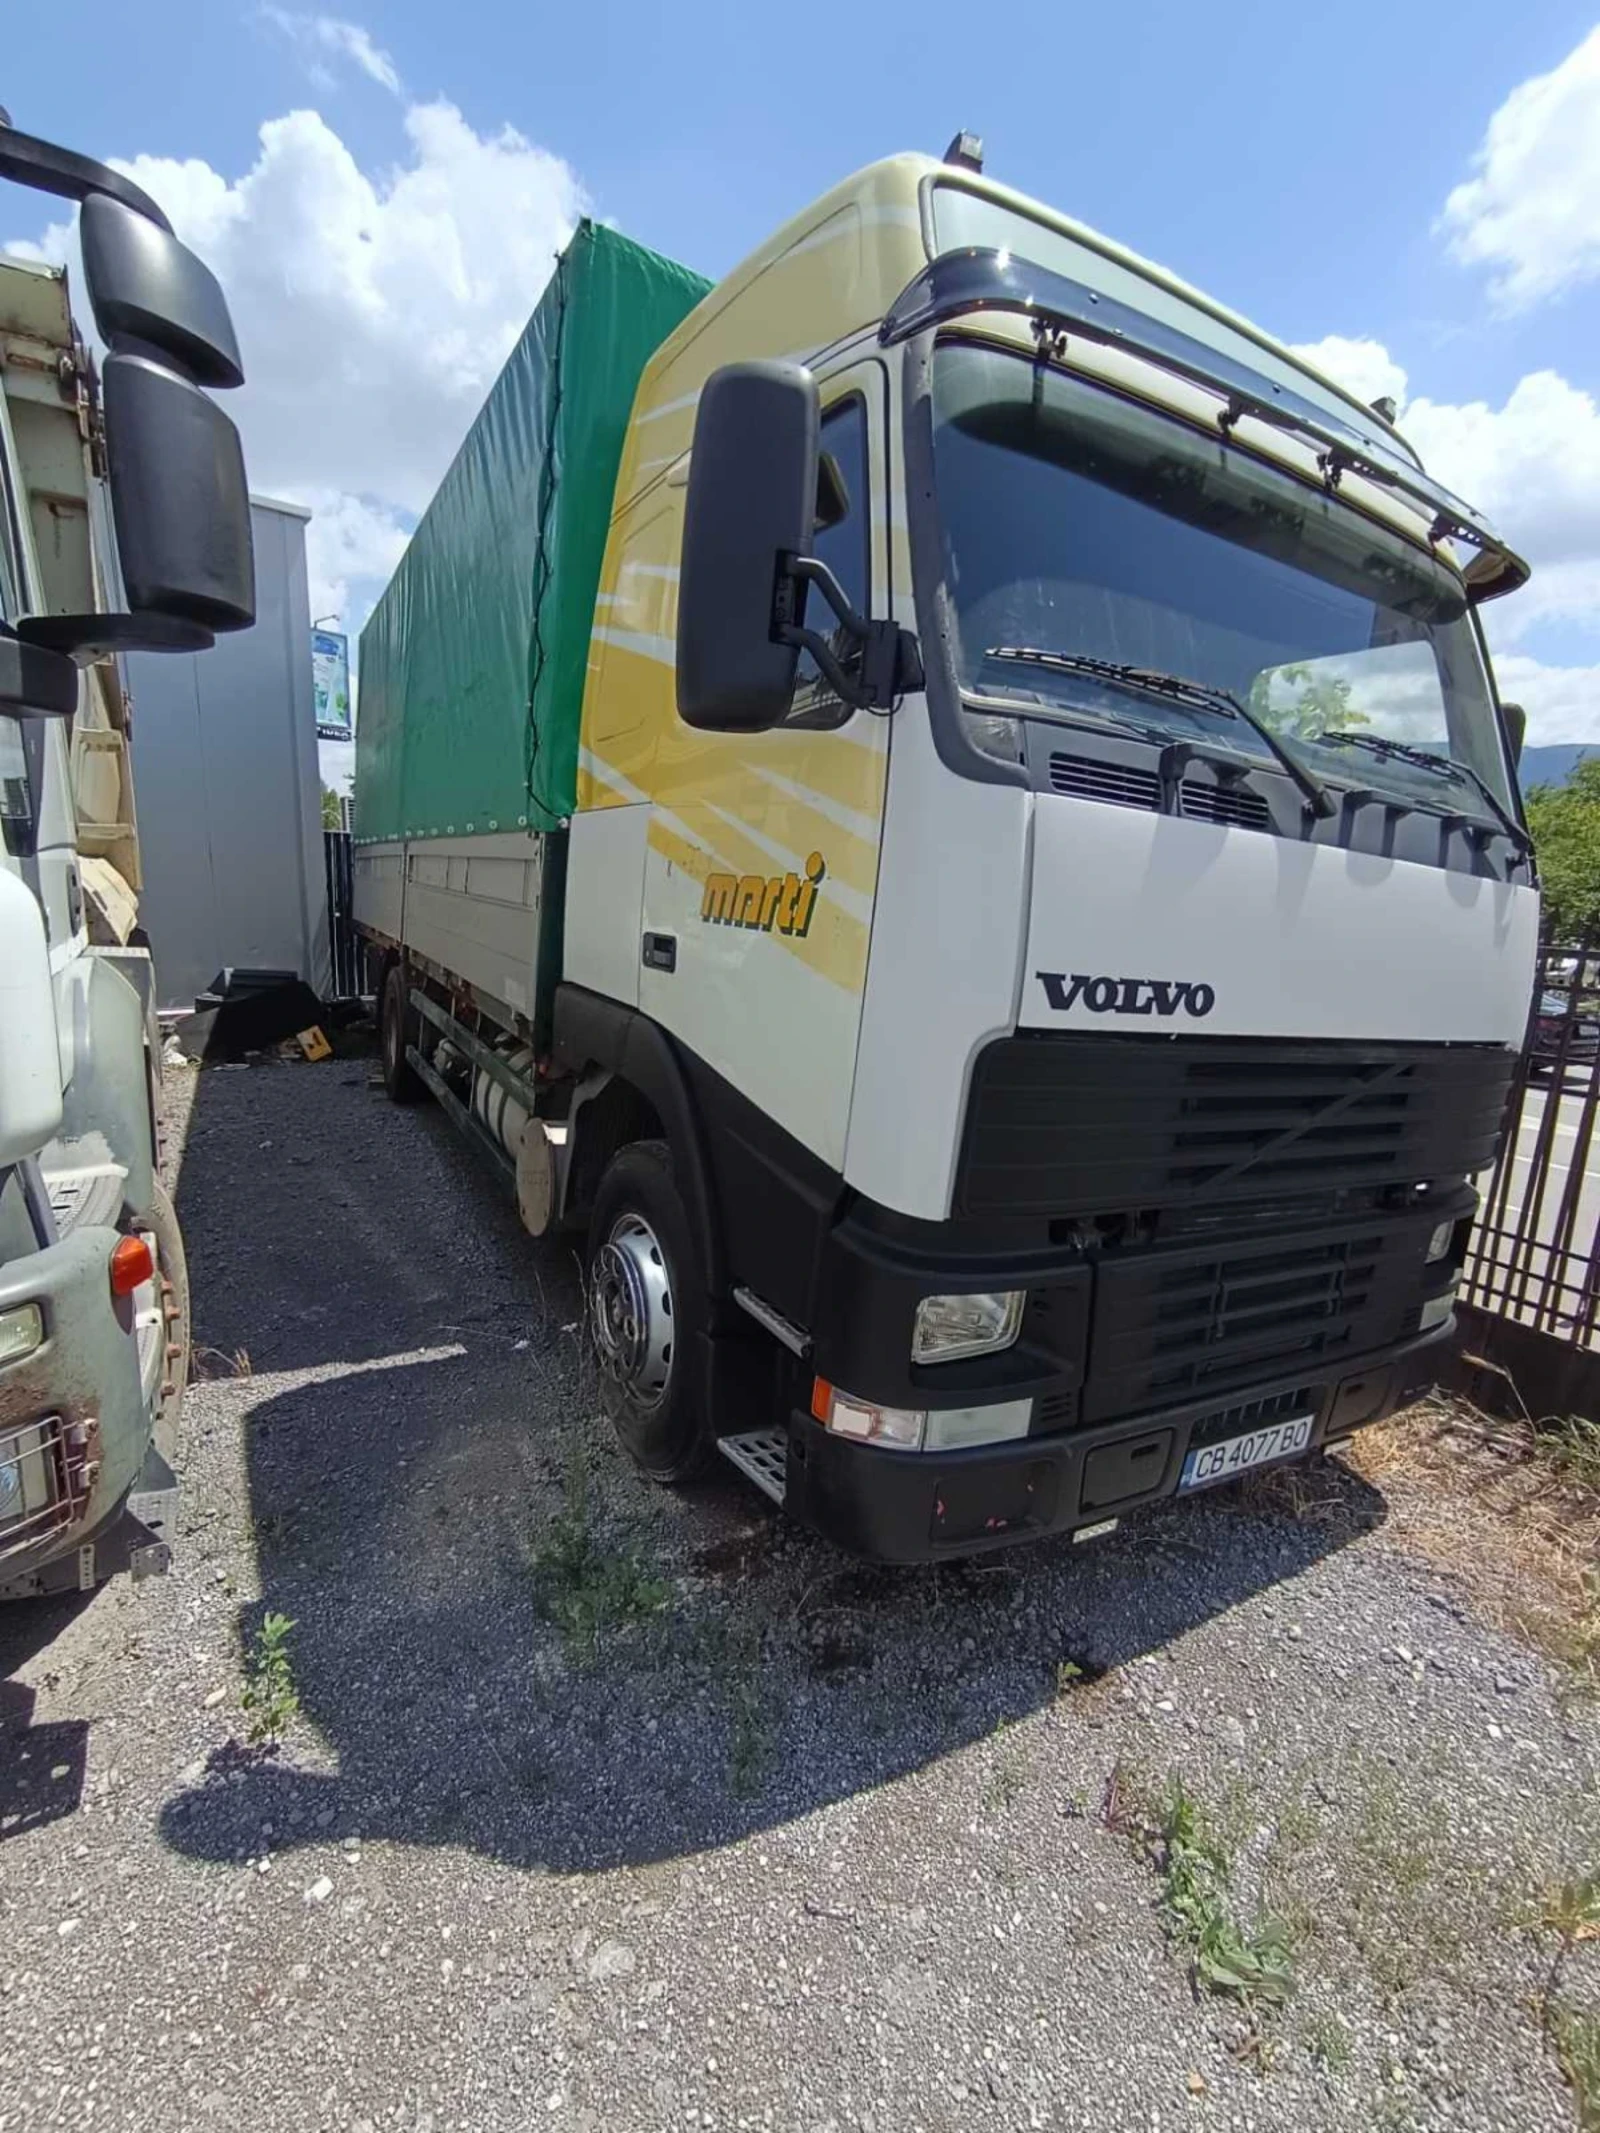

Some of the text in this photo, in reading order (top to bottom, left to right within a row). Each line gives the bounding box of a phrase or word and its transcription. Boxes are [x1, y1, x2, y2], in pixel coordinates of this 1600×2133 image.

[702, 851, 825, 938] marti
[1035, 971, 1215, 1017] VOLVO
[1196, 1421, 1308, 1478] CB 4077 BO
